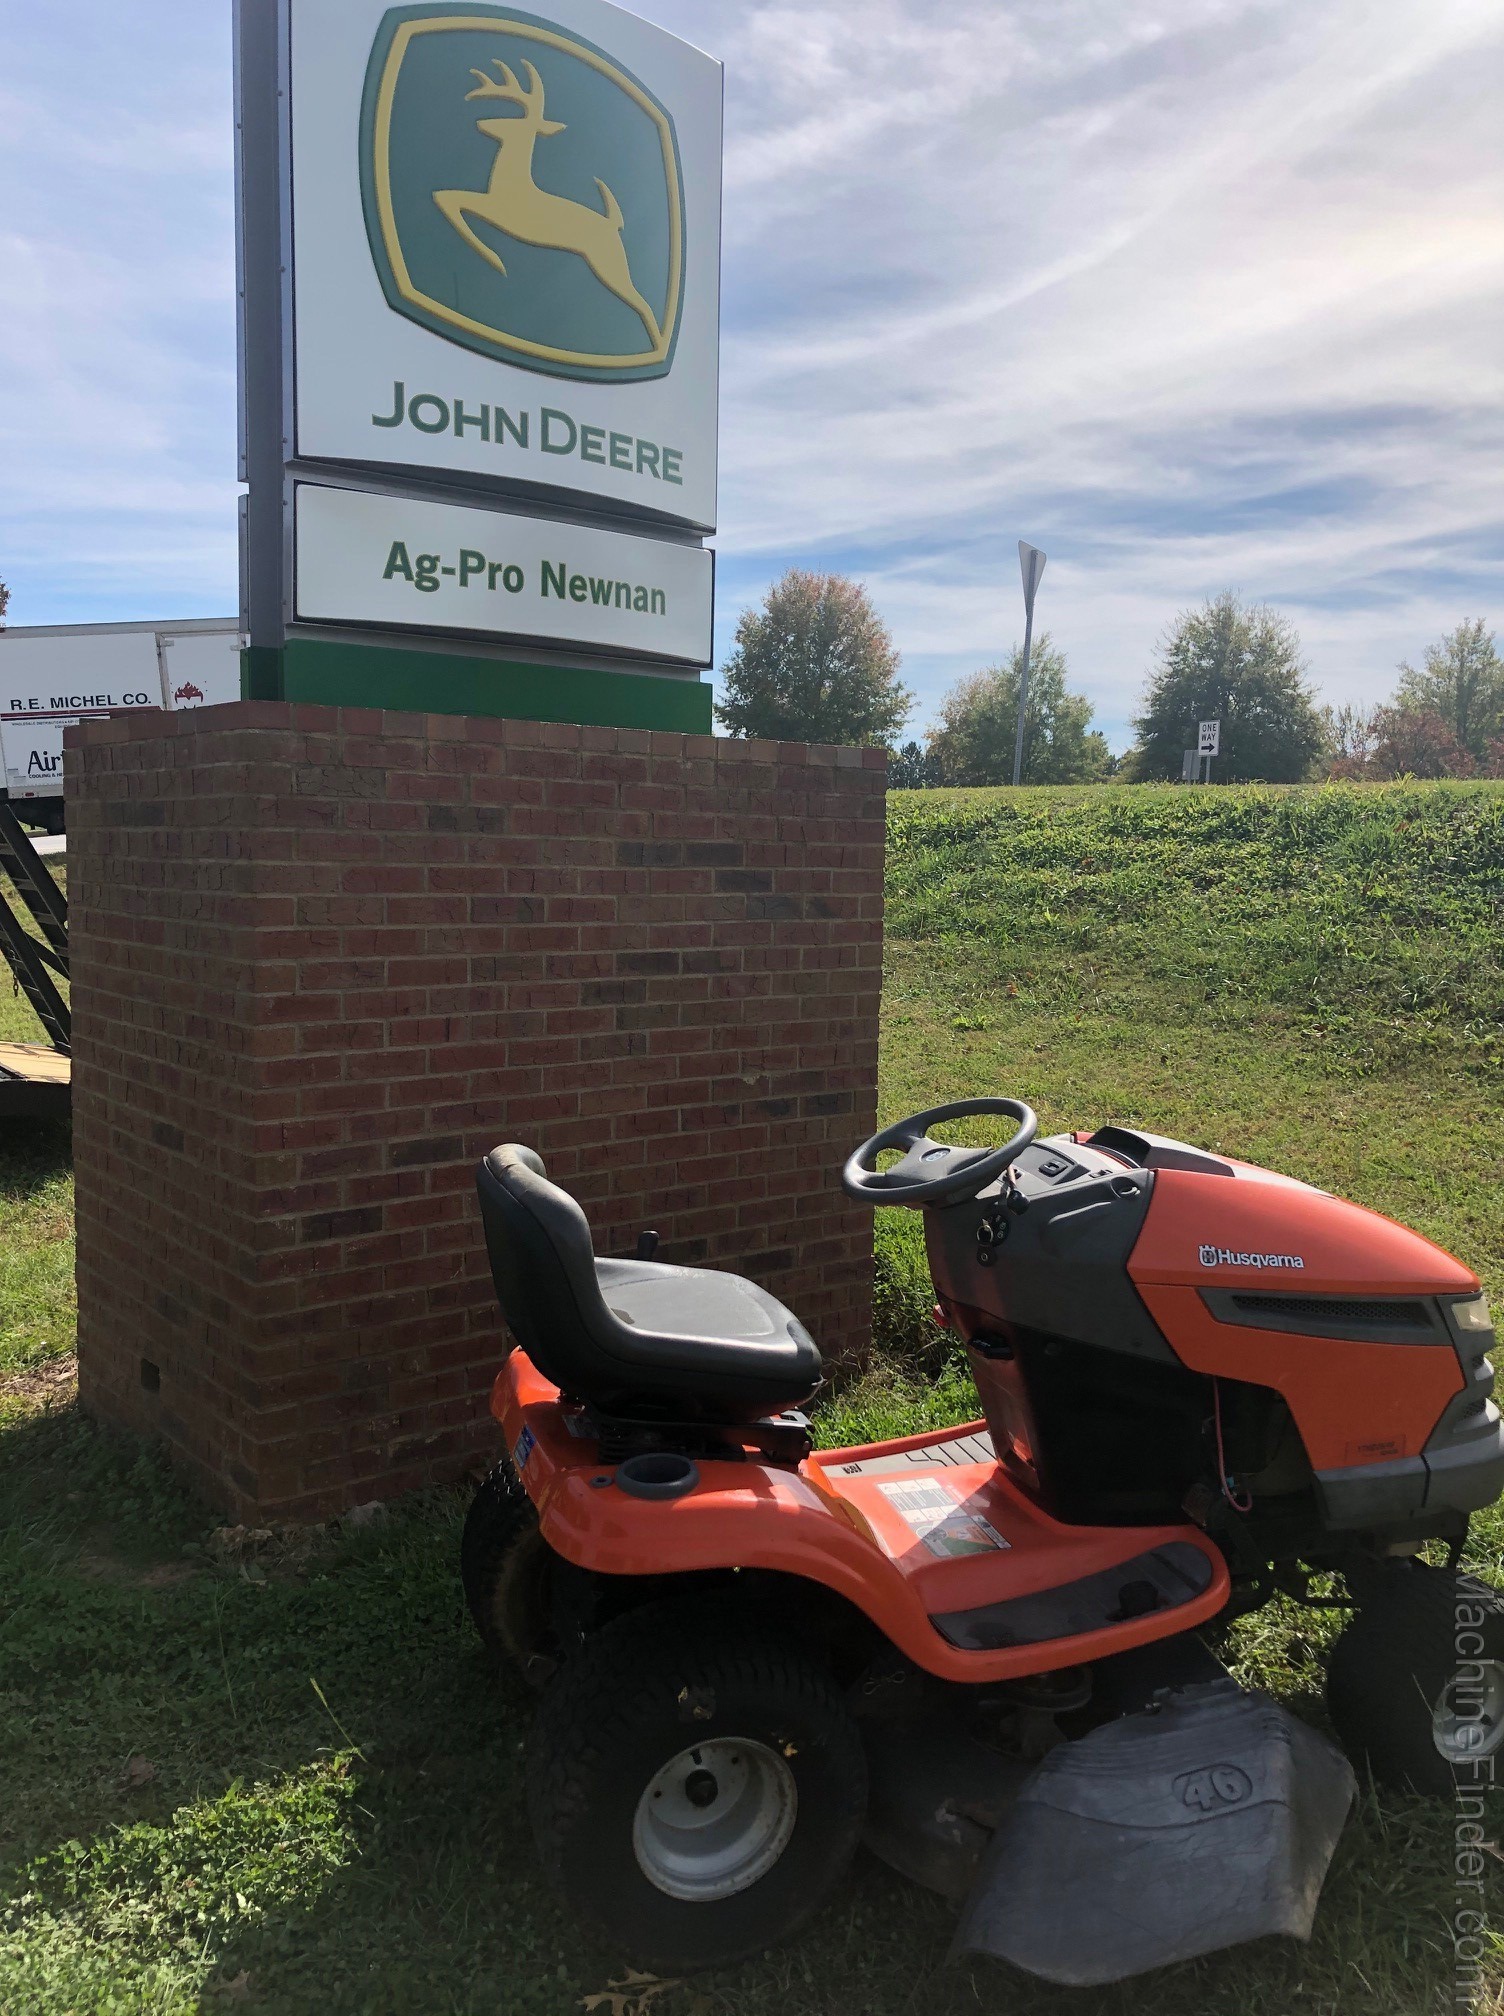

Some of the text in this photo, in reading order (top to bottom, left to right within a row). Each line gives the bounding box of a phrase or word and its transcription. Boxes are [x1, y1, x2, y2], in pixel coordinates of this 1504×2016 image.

[372, 381, 683, 486] JOHN DEERE
[382, 541, 666, 616] Ag-Pro Newnan
[10, 693, 152, 710] R.E. MICHEL CO.
[1202, 733, 1216, 741] WAY
[1203, 723, 1217, 732] ONE
[28, 750, 65, 774] Air
[1218, 1249, 1304, 1268] Husqvarna
[1184, 1767, 1244, 1811] 46
